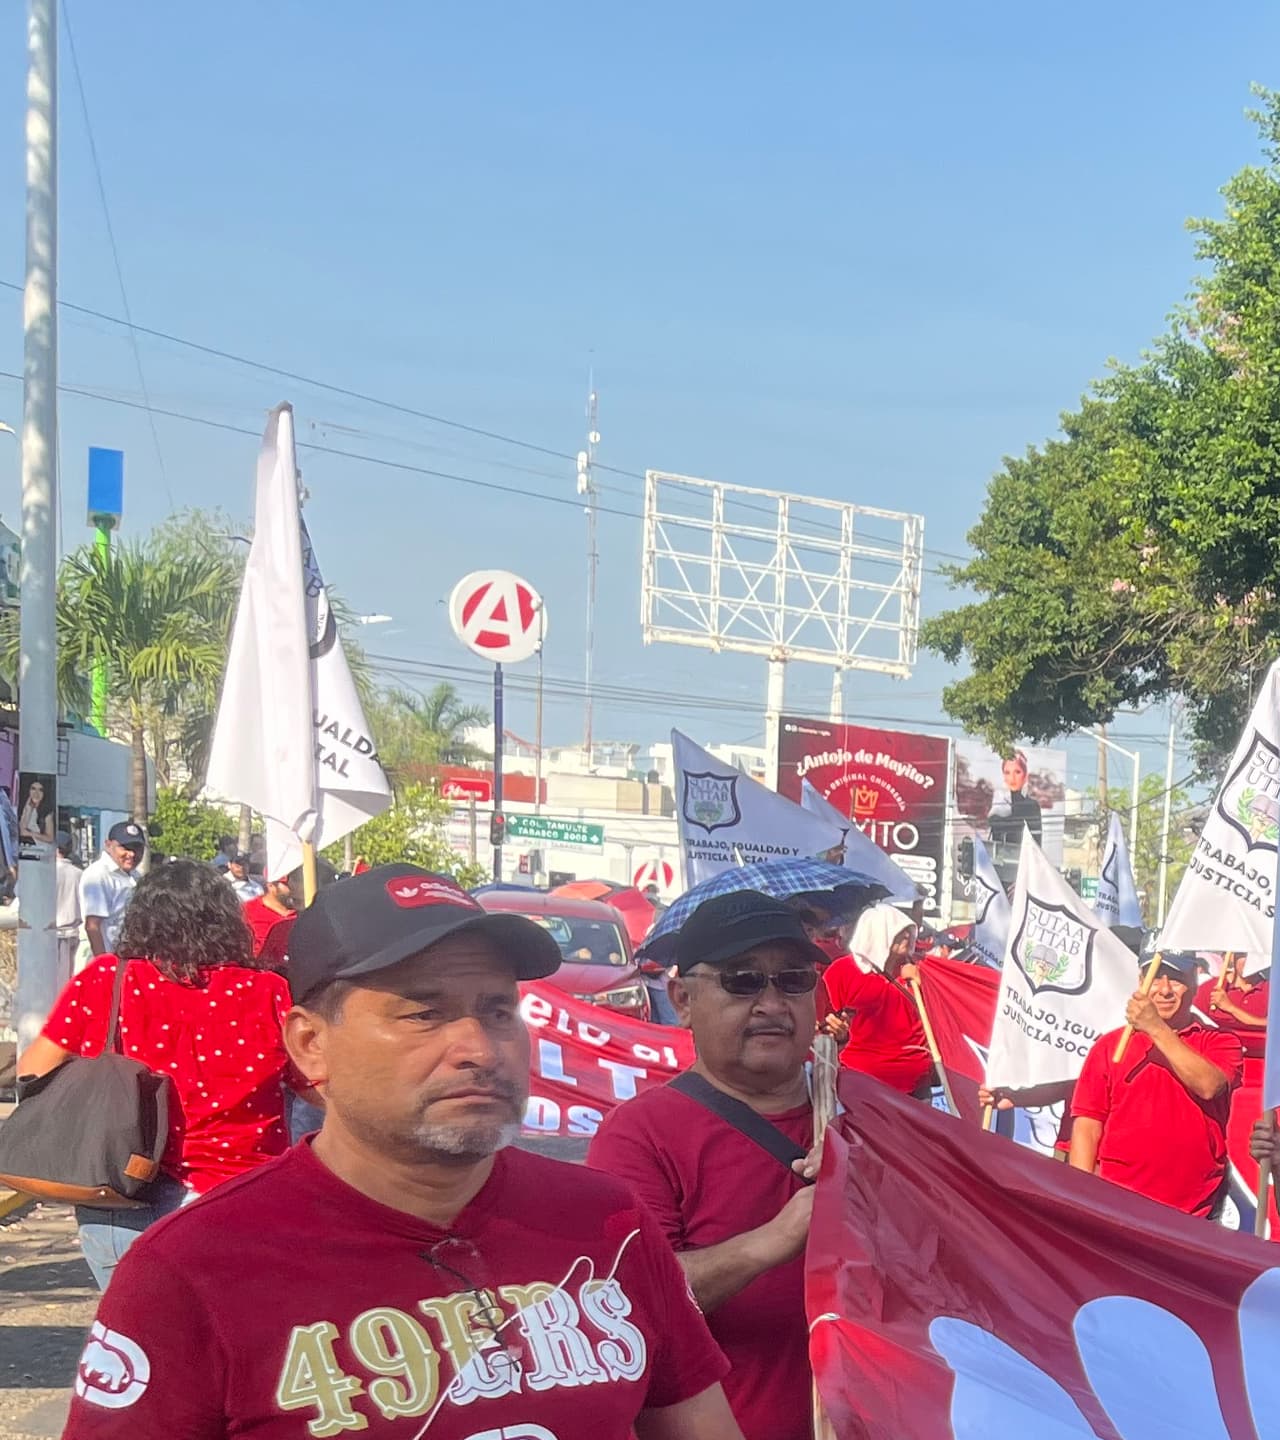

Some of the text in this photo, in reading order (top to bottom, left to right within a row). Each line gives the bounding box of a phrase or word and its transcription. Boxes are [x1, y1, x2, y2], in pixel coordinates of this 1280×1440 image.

[796, 748, 935, 789] ¿Antojo de Mayito?
[518, 826, 588, 842] TABASCO 2000
[732, 842, 790, 855] IGUALDAD
[792, 848, 799, 856] Y
[1189, 856, 1262, 911] JUSTICIA
[1199, 836, 1273, 897] TRABAJO,
[1026, 922, 1080, 955] UTTAB
[1028, 907, 1084, 942] SUTAA
[1002, 1003, 1052, 1046] JUSTICIA
[1005, 986, 1059, 1031] TRABAJO,
[276, 1278, 647, 1439] 49ERS
